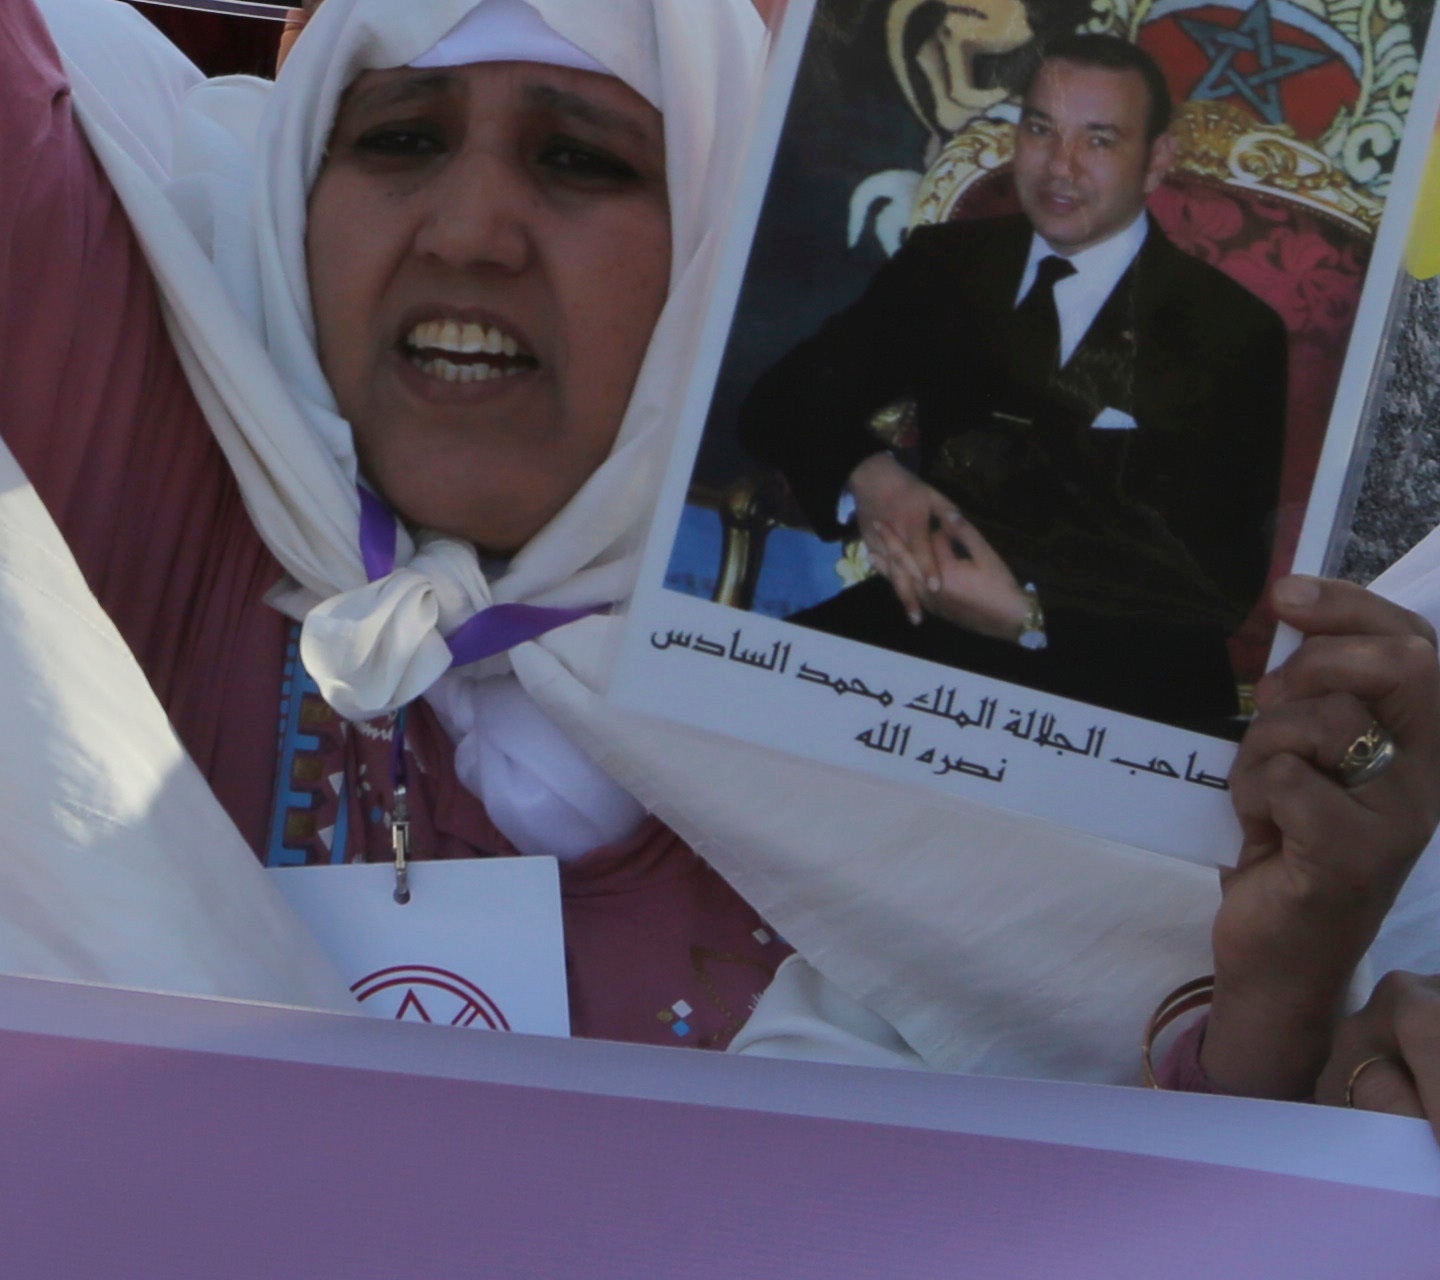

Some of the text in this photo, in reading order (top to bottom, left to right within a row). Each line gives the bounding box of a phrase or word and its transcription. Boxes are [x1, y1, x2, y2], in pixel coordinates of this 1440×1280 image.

[650, 627, 1230, 791] صاحب الجلالة الملك محمد السادس
[854, 720, 1008, 784] نصره الله
